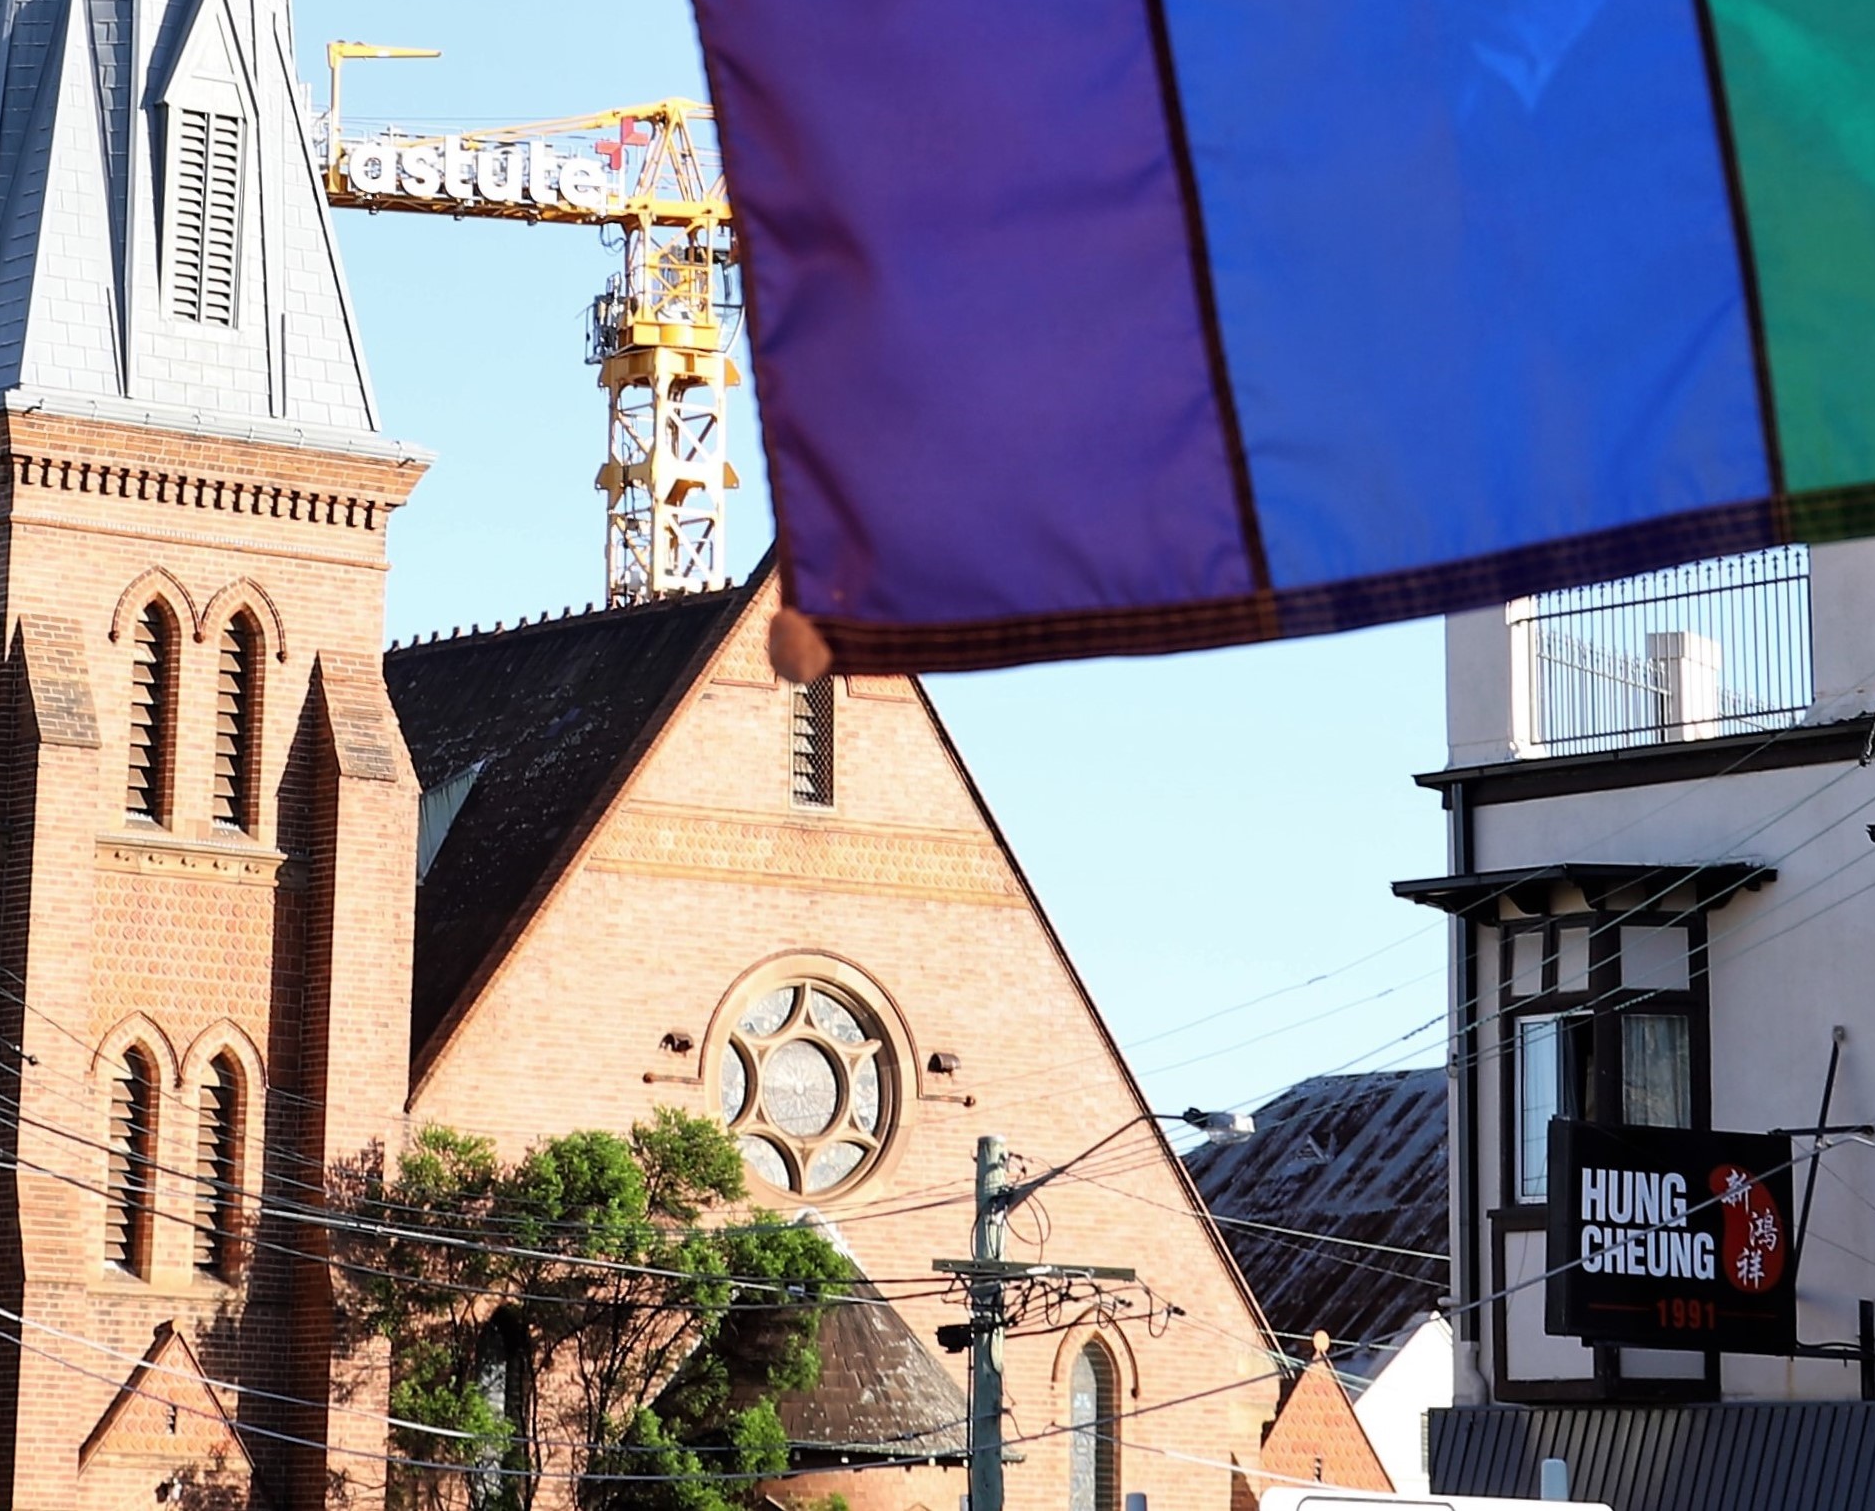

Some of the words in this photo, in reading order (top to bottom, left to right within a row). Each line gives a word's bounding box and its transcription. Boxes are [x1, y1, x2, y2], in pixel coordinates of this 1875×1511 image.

[349, 134, 608, 209] astute
[1581, 1168, 1687, 1227] HUNG
[1581, 1226, 1715, 1280] CHEUNG
[1721, 1169, 1779, 1289] 新鴻祥
[1657, 1298, 1716, 1330] 1991
